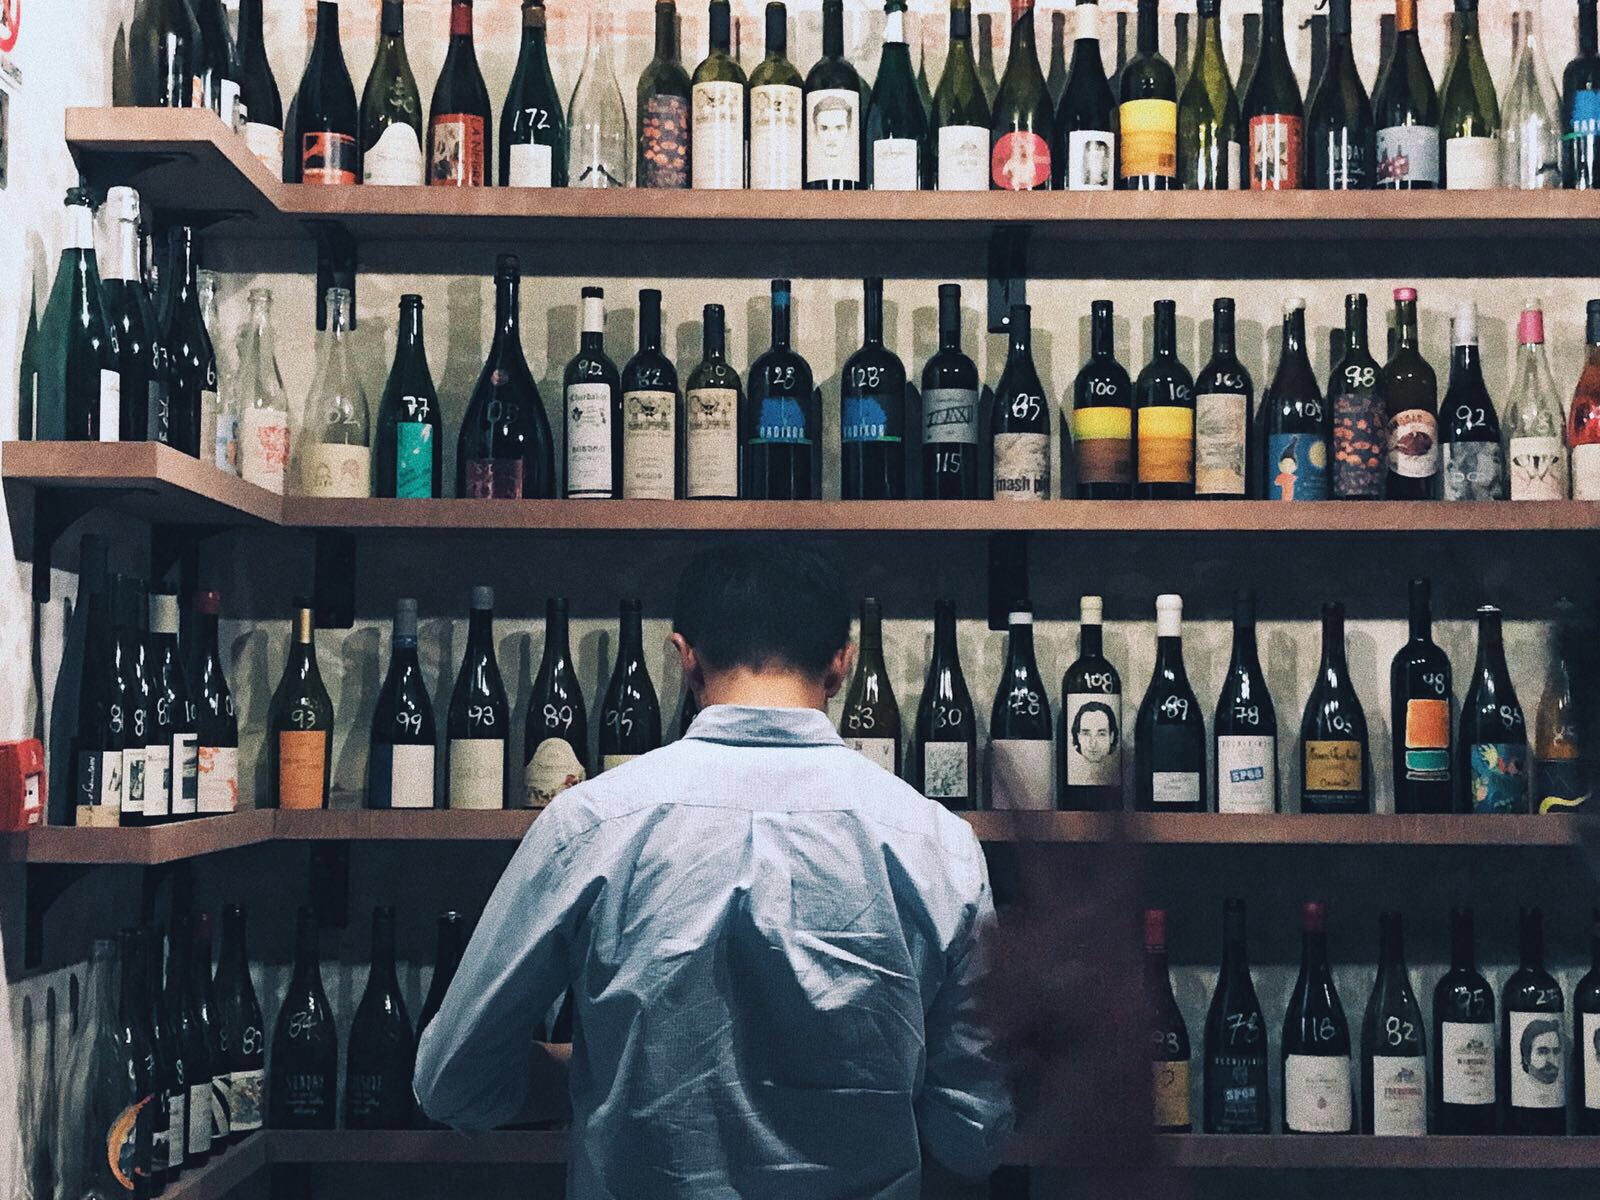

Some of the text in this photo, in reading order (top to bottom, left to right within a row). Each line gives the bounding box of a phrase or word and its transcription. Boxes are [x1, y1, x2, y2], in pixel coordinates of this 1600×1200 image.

[512, 107, 551, 132] 172
[765, 366, 796, 390] 128
[851, 366, 881, 388] 128
[1345, 365, 1376, 388] 98
[1089, 381, 1117, 396] 100
[402, 396, 430, 418] 77
[1456, 405, 1486, 430] 92
[936, 453, 961, 473] 115
[996, 476, 1030, 492] mash
[1085, 672, 1113, 693] 108
[468, 705, 495, 727] 93
[543, 703, 573, 730] 89
[1164, 695, 1189, 720] 89
[1234, 705, 1259, 725] 78
[291, 709, 316, 730] 93
[396, 711, 423, 735] 99
[606, 707, 633, 737] 95
[1386, 1016, 1417, 1046] 82
